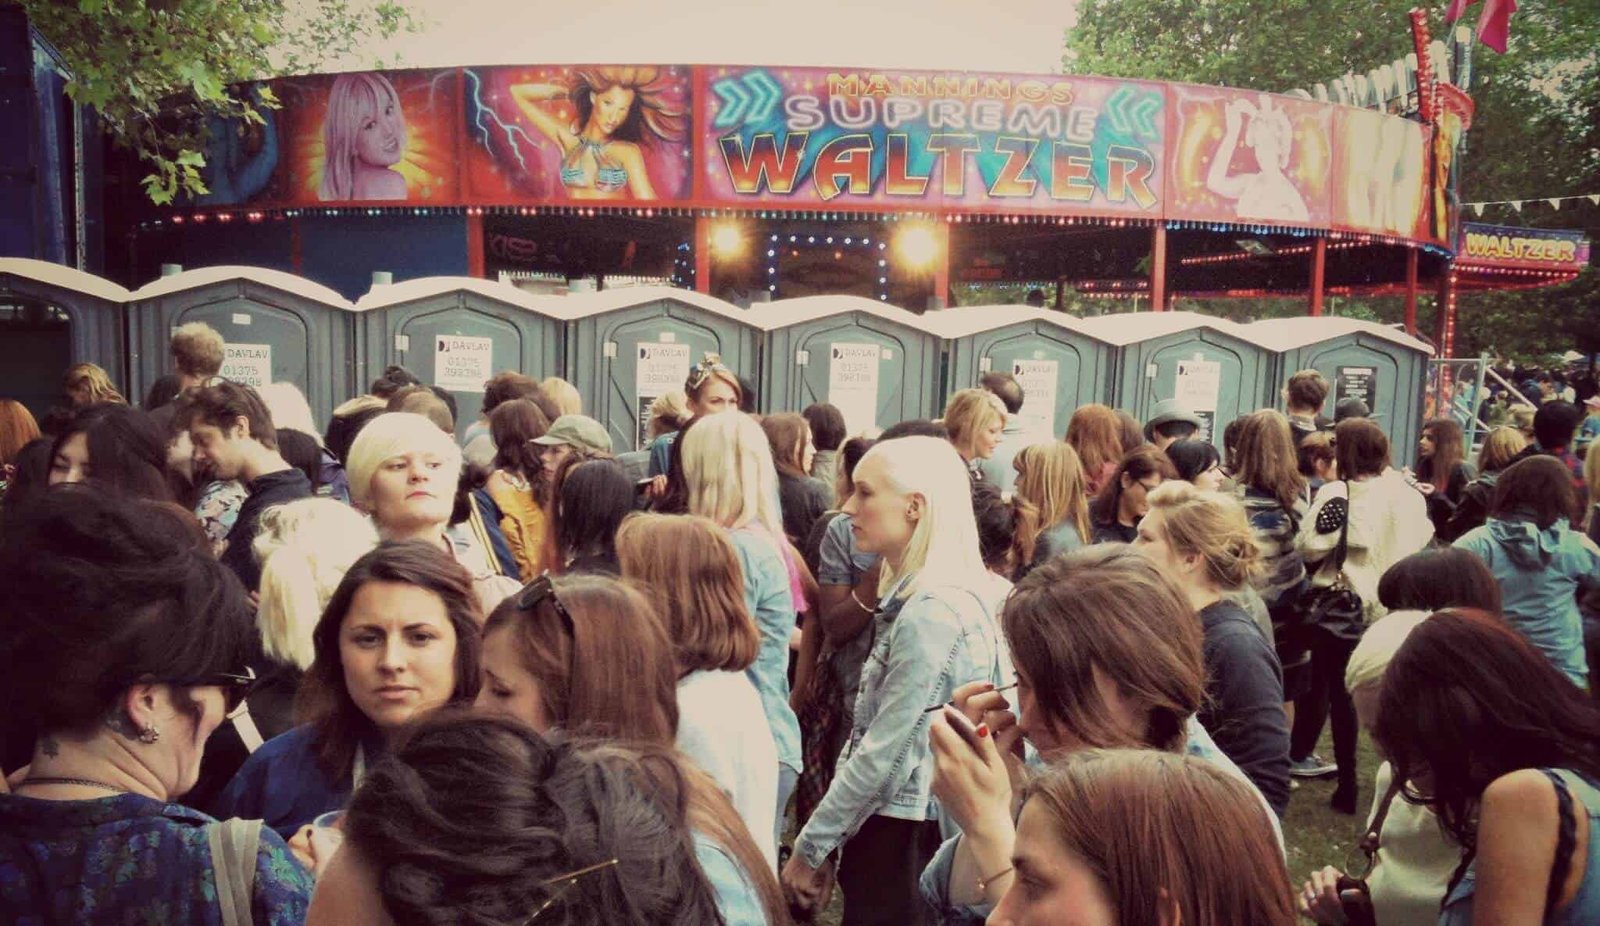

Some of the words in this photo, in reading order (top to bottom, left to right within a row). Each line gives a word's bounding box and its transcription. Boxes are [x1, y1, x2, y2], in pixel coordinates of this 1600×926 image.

[827, 73, 1074, 105] MANNINGS
[785, 95, 1100, 143] SUPREME
[719, 132, 1158, 209] WALTZER
[1466, 232, 1576, 262] WALTZER
[227, 348, 268, 360] DAVLAV
[452, 340, 490, 352] DAVLAV
